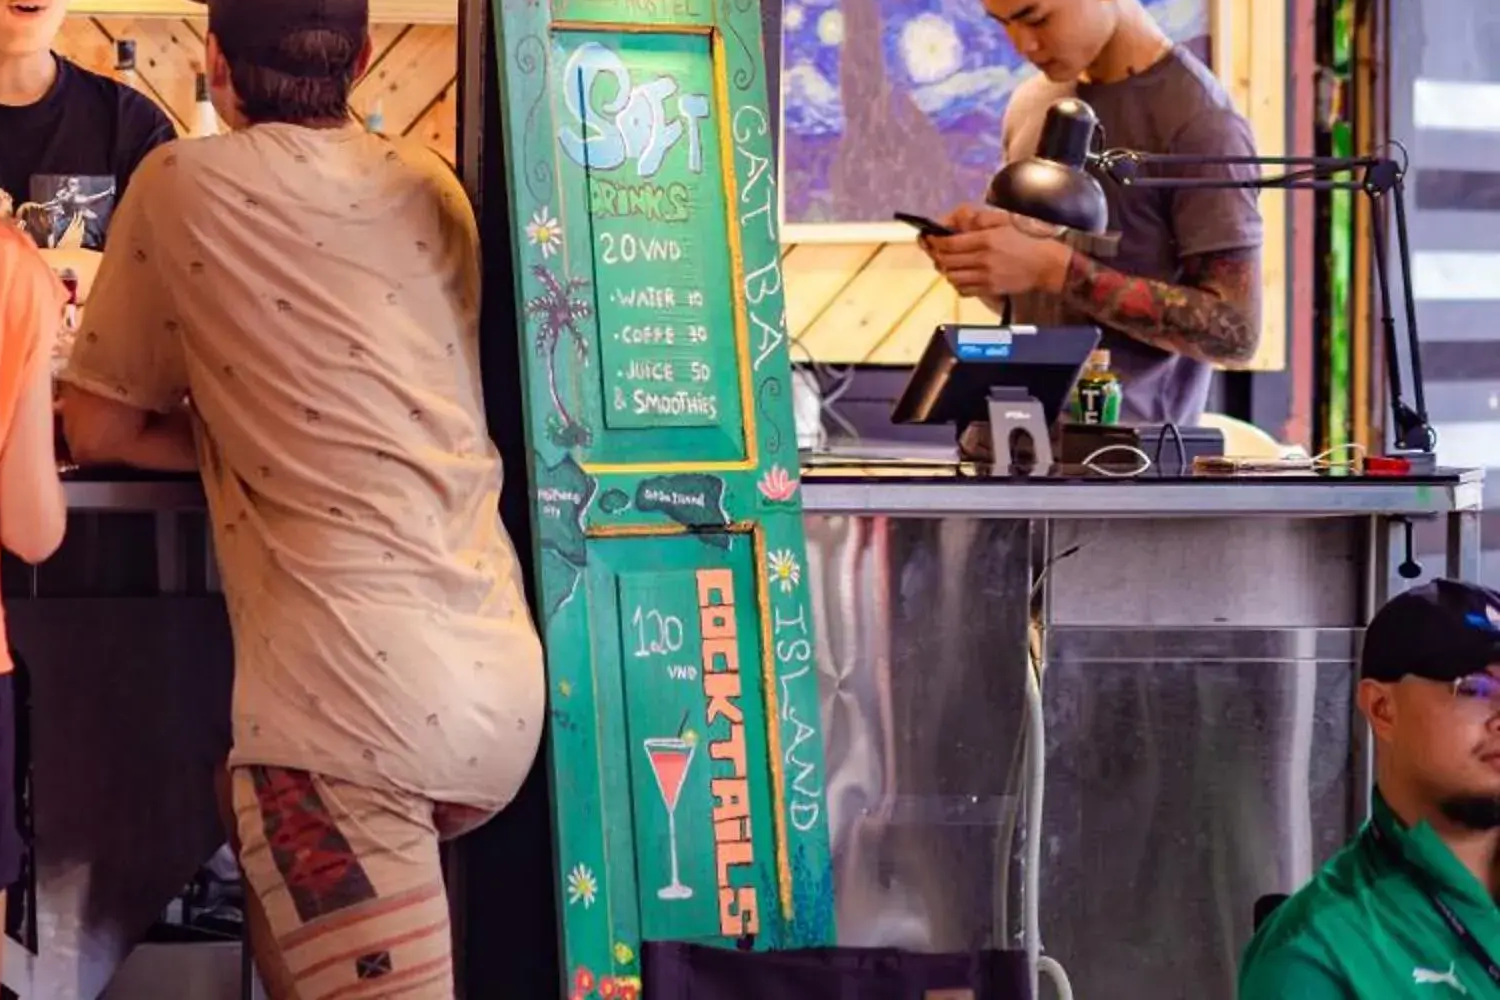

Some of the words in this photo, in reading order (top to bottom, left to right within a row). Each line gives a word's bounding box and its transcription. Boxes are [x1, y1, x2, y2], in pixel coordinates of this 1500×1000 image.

[587, 177, 691, 222] DRINKS
[616, 287, 675, 308] WATER
[625, 360, 675, 382] JUICE
[691, 361, 711, 382] 50
[633, 605, 683, 658] 120
[666, 664, 698, 681] VND
[775, 603, 819, 831] ISLAND
